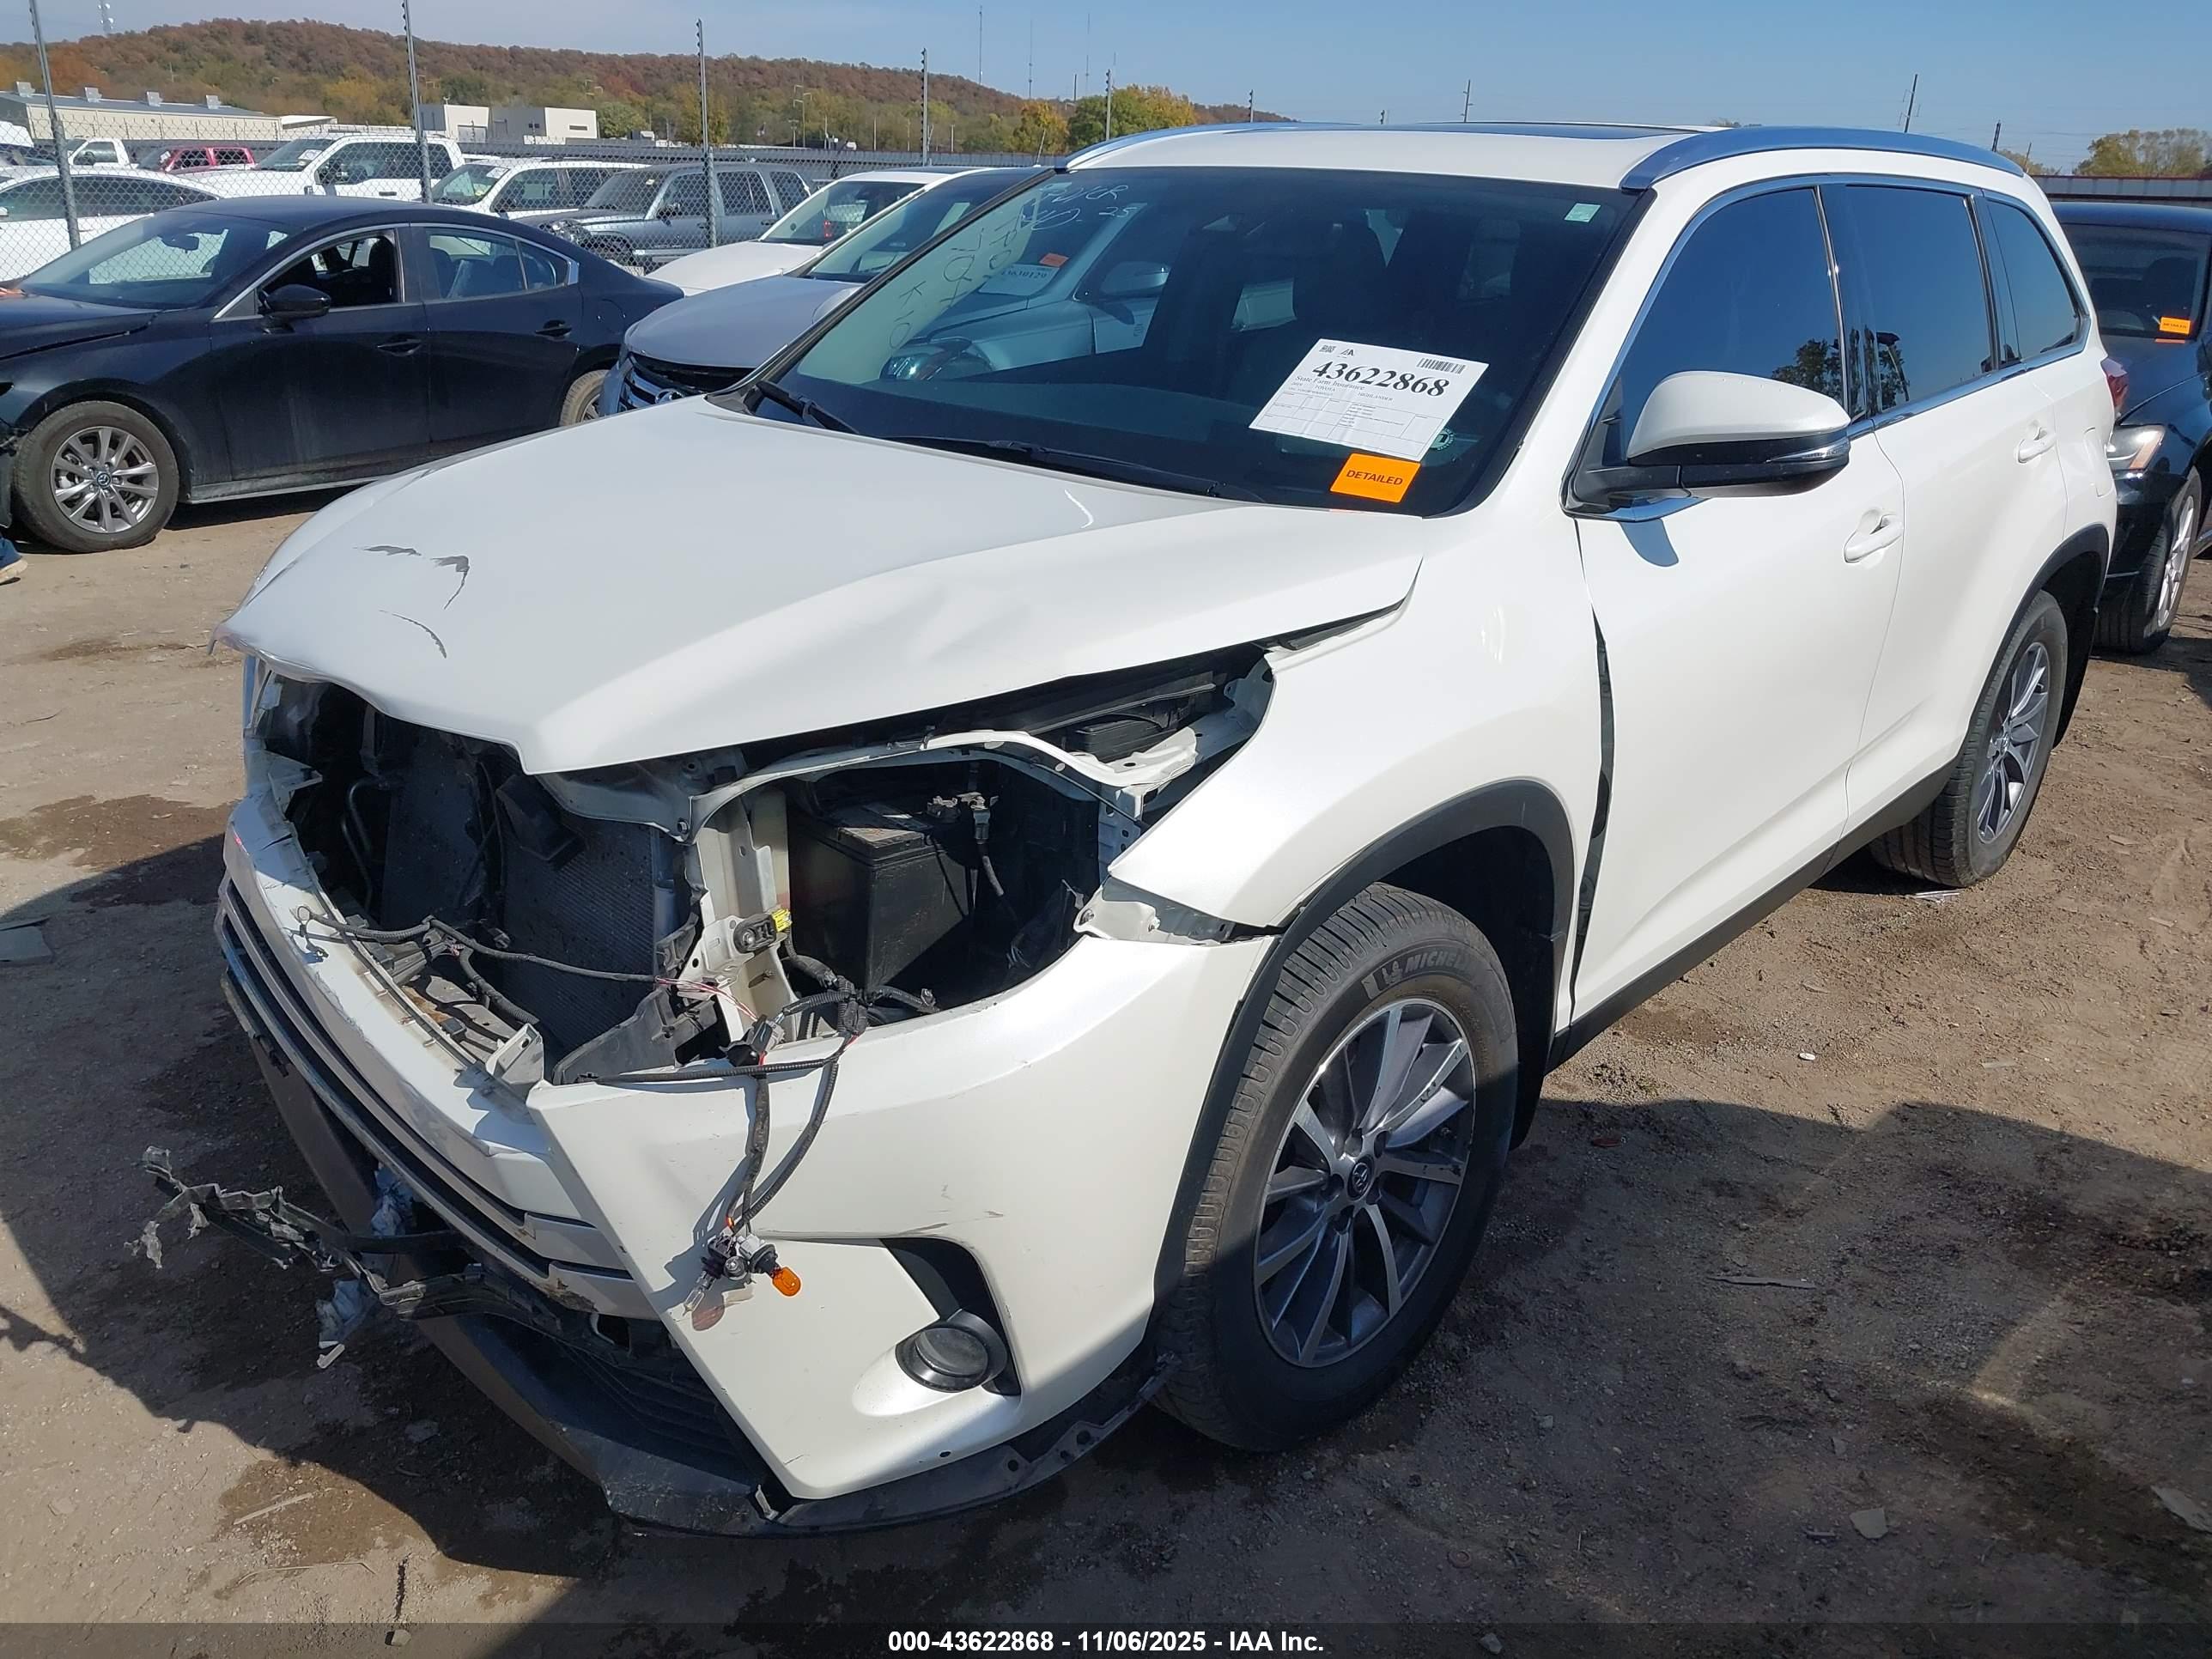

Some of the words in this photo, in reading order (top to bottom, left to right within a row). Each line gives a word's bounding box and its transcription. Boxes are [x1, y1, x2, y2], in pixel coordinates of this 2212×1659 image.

[1312, 361, 1449, 397] 43622868
[1313, 377, 1331, 386] Farm
[1332, 379, 1365, 391] Insurance
[1346, 470, 1403, 485] DETAILED
